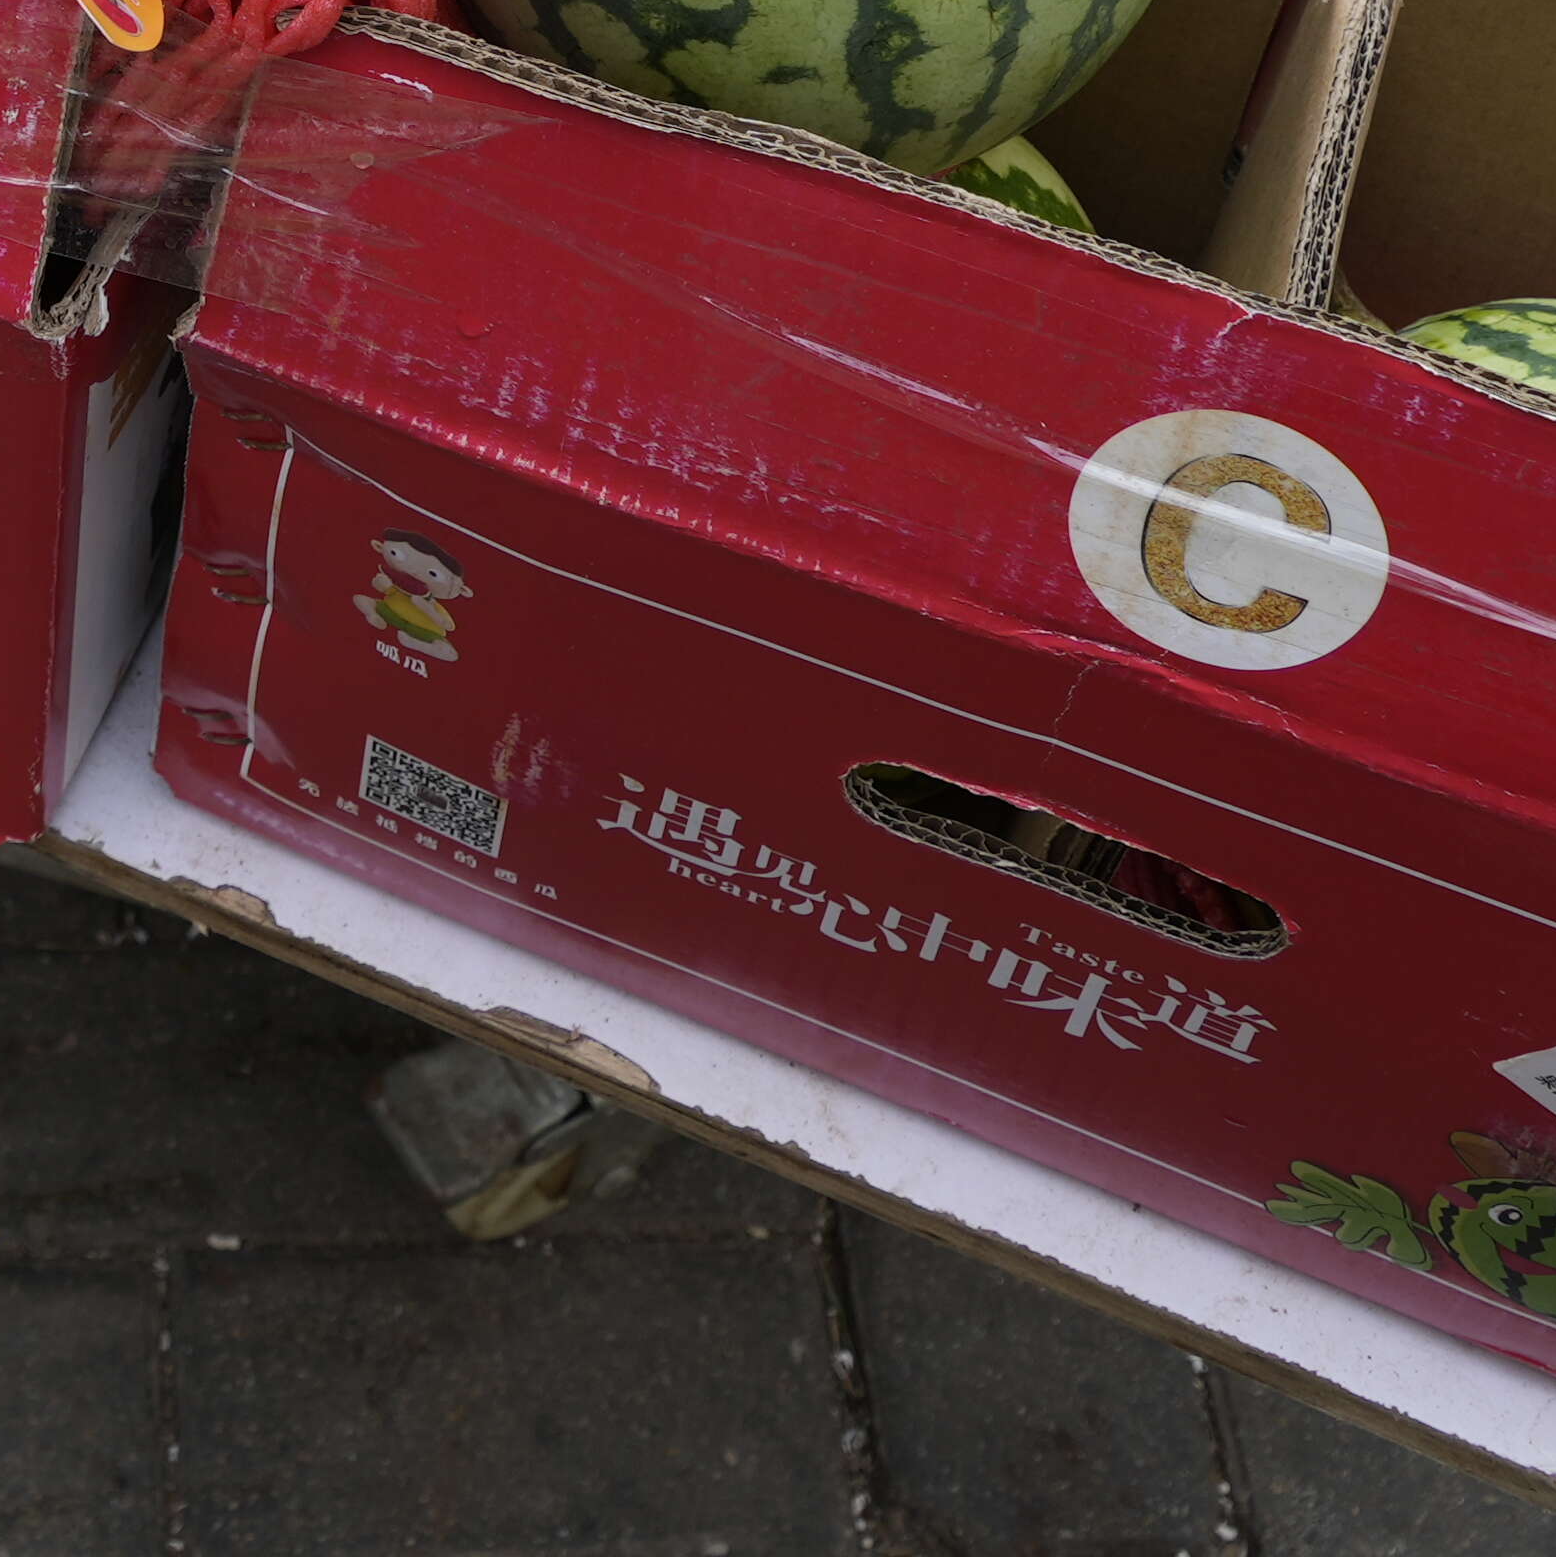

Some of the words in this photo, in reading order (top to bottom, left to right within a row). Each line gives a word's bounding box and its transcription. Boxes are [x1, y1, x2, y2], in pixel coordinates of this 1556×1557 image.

[1140, 452, 1333, 634] C
[374, 637, 430, 680] 呱瓜
[298, 777, 560, 902] 无法抵挡的西瓜
[665, 854, 790, 916] heart
[594, 771, 1279, 1066] 遇见心中味道
[1018, 921, 1147, 986] Taste
